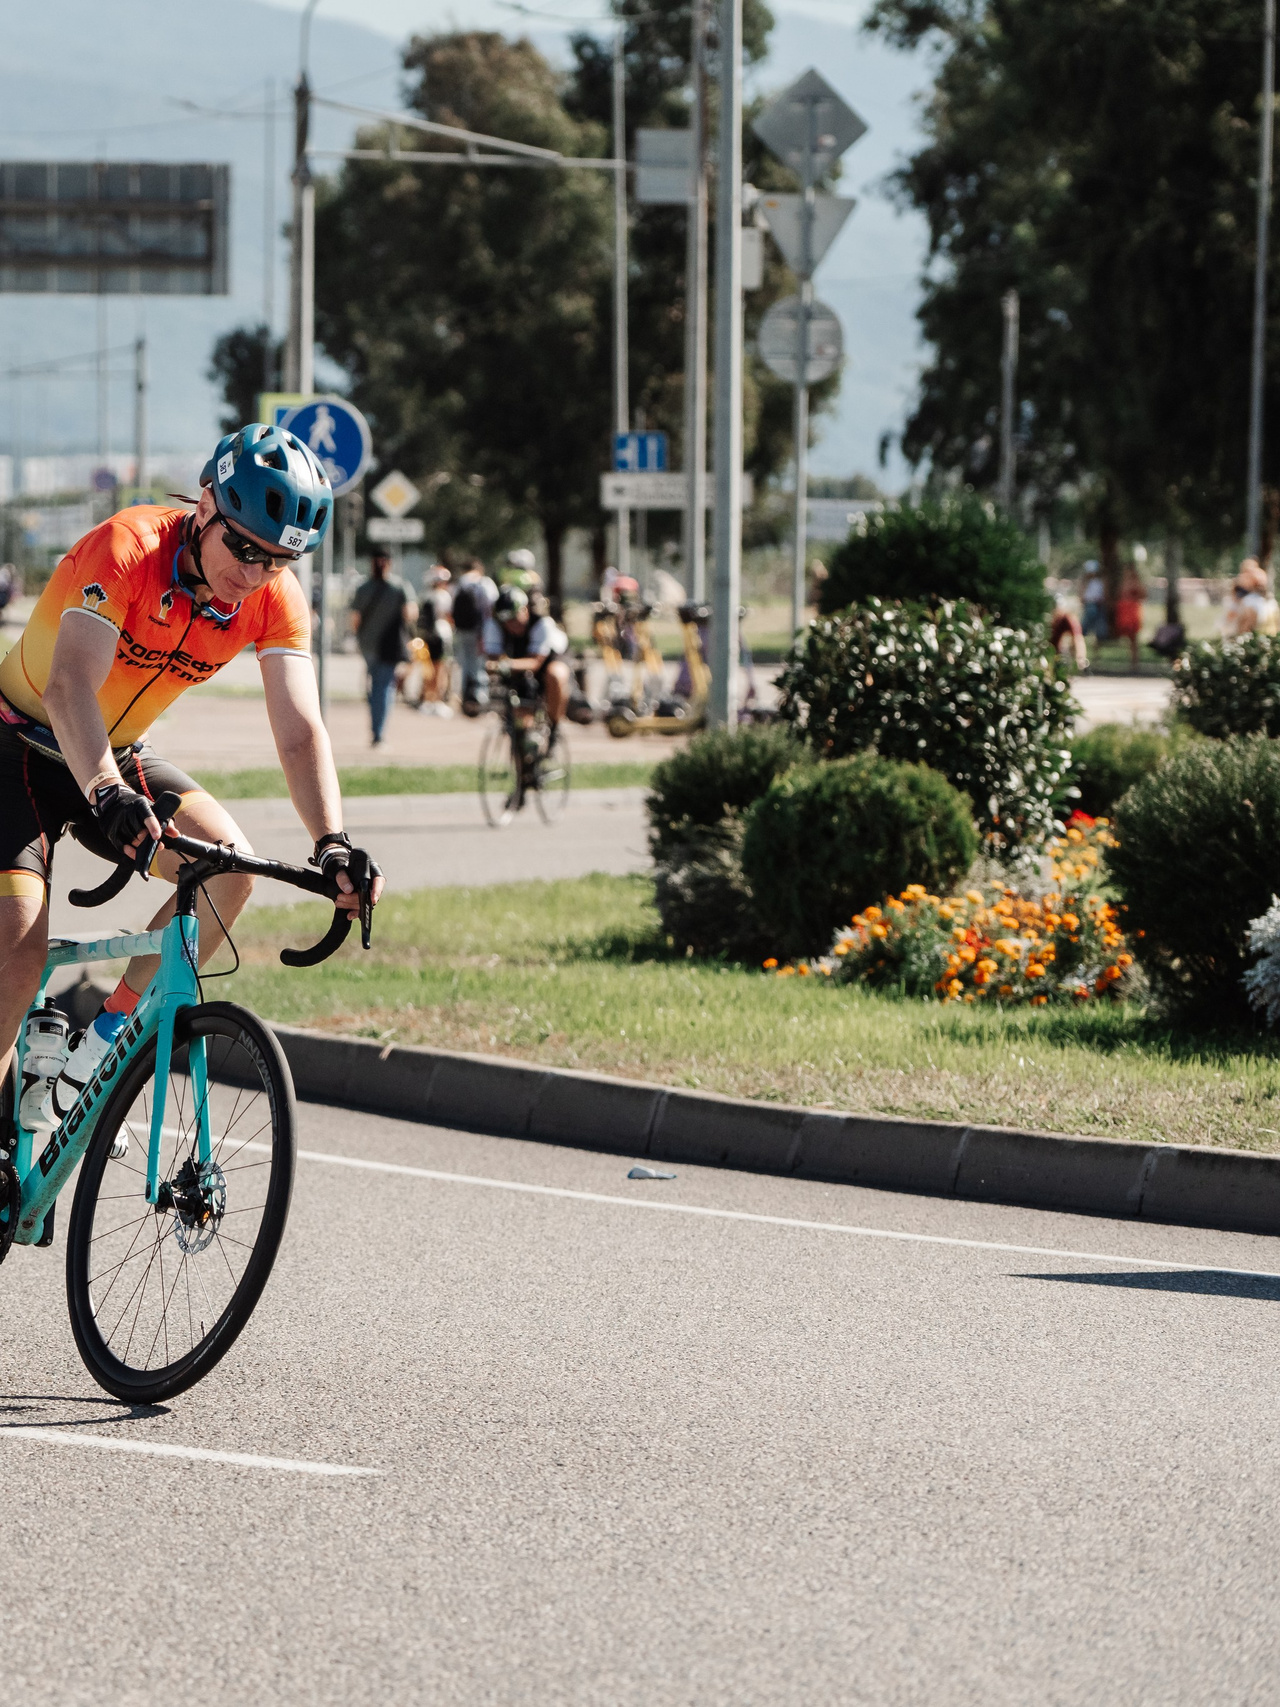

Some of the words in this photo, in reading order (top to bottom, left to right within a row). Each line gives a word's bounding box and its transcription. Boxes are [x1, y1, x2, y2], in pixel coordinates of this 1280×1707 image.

[287, 536, 303, 548] 587
[117, 648, 212, 683] ТРИАТЛО
[120, 629, 228, 673] РОСНЕФТ
[39, 1007, 144, 1178] Bianchi
